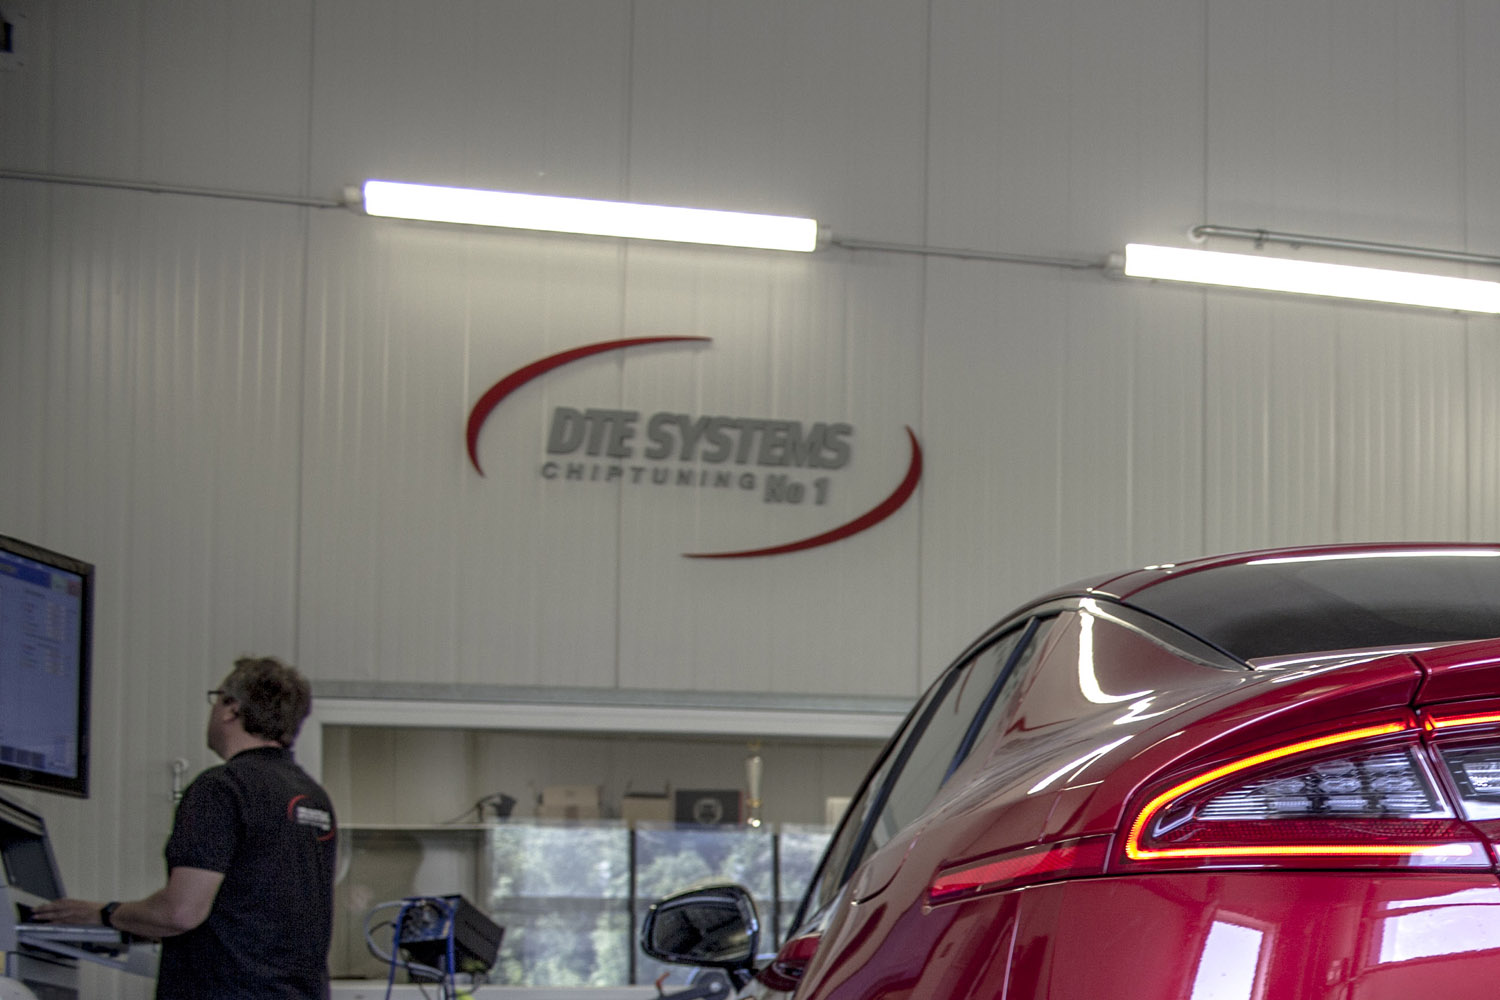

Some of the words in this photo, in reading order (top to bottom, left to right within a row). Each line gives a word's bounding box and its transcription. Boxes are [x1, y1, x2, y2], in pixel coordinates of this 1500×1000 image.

[546, 406, 641, 459] DTE
[644, 411, 855, 470] SYSTEMS
[541, 461, 758, 490] CHIPTUNING
[811, 477, 830, 505] 1
